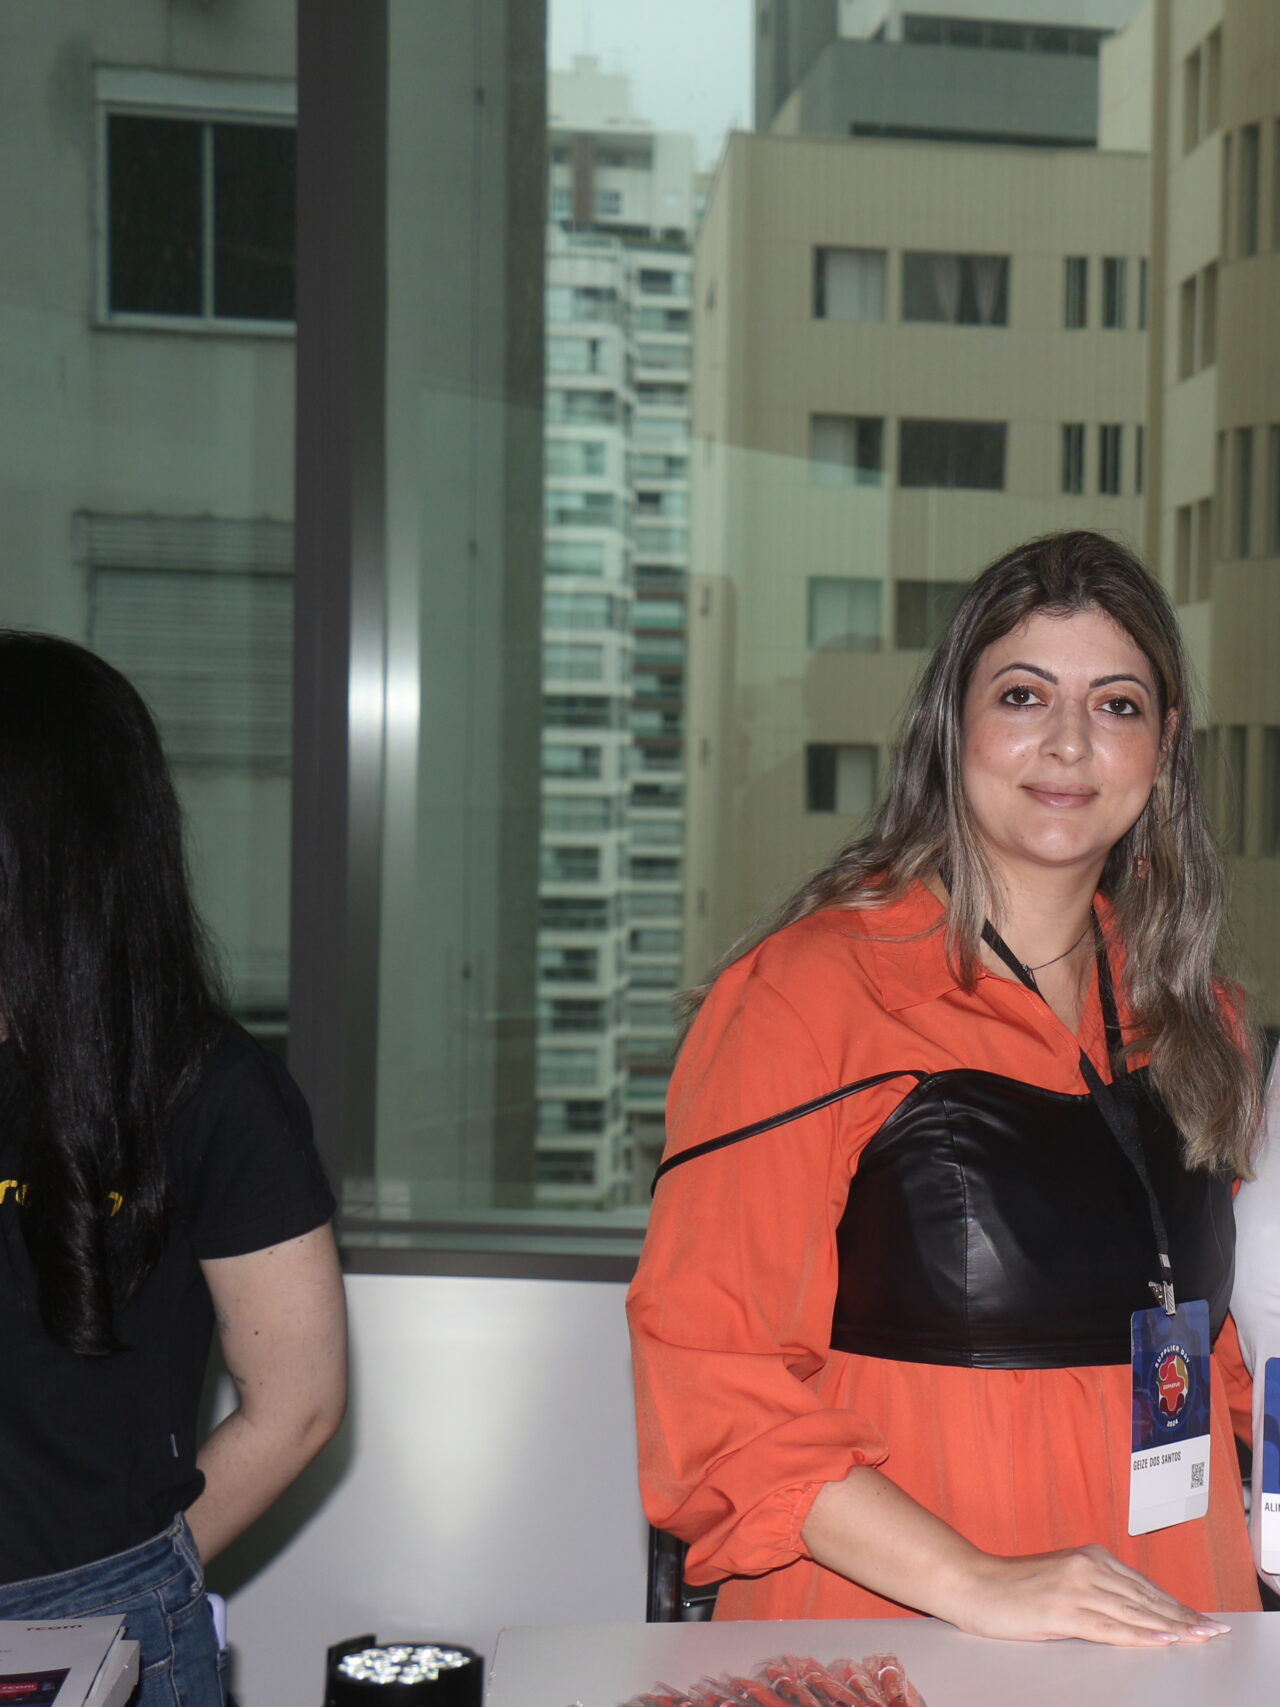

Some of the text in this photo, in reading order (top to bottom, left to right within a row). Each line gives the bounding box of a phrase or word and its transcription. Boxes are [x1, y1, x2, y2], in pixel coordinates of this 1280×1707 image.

[1155, 1344, 1191, 1368] SUPPLIER DAY
[1166, 1419, 1179, 1428] 2024
[1133, 1451, 1181, 1471] GEIZE DOS SANTOS
